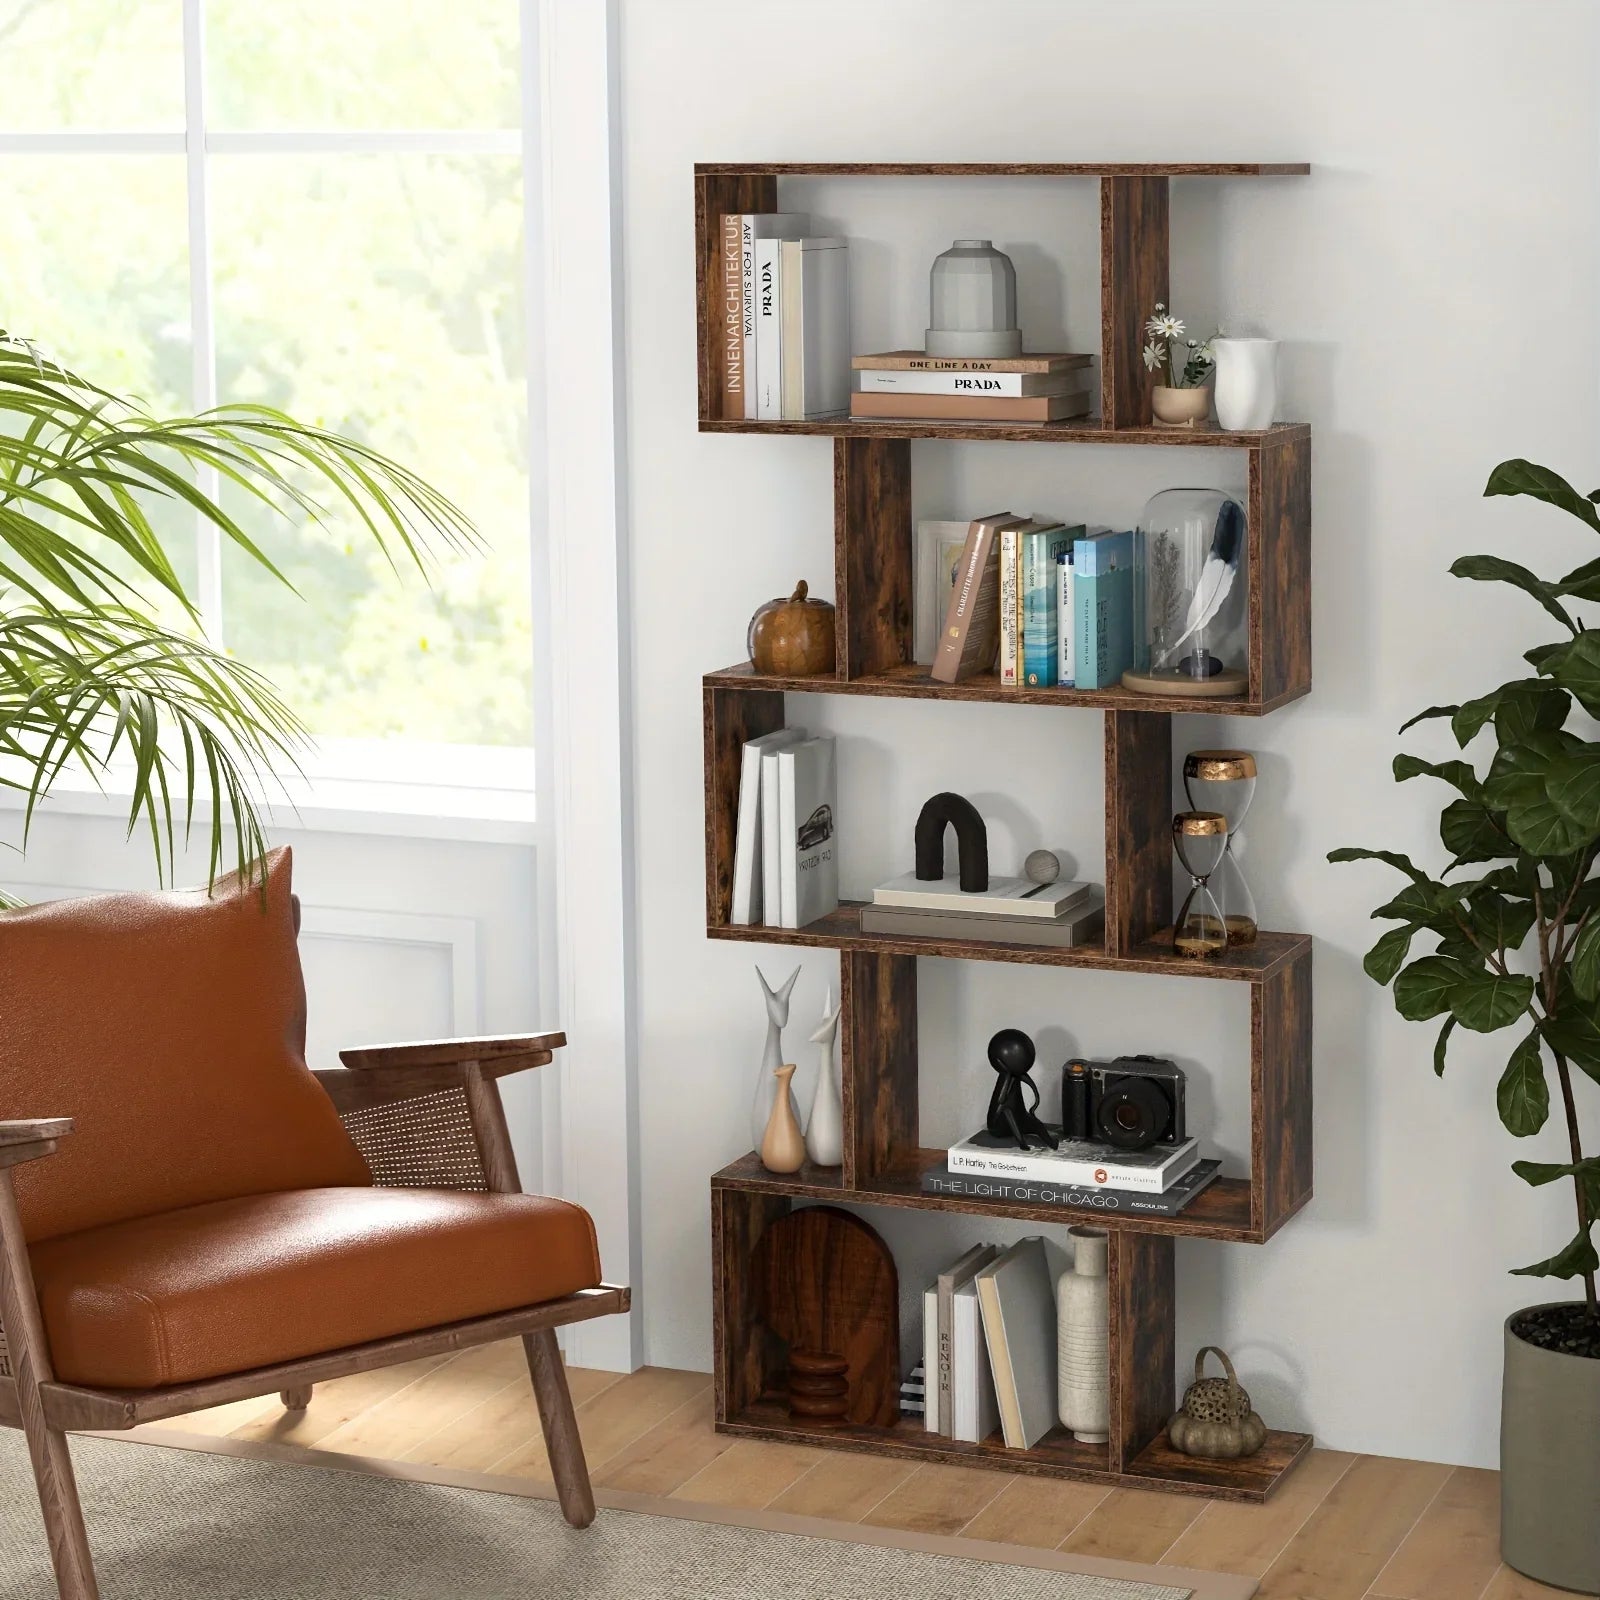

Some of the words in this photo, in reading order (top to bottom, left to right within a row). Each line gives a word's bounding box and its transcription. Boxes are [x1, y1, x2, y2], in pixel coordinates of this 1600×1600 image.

[743, 223, 751, 246] ART
[743, 252, 752, 277] FOR
[762, 262, 772, 316] PRADA
[725, 215, 740, 393] INNENARCHITEKTUR
[744, 282, 753, 338] SURVIVAL
[910, 361, 930, 369] ONE
[934, 362, 958, 370] LINE
[962, 362, 968, 370] A
[972, 362, 992, 370] DAY
[954, 379, 1002, 390] PRADA
[957, 577, 973, 617] CHARLOTTE
[989, 1161, 997, 1169] The
[930, 1178, 962, 1193] THE
[965, 1182, 1012, 1197] LIGHT
[1014, 1187, 1038, 1199] OF
[1040, 1190, 1119, 1209] CHICAGO
[1131, 1202, 1169, 1211] ASSOULINE
[940, 1333, 950, 1391] RENOIR
